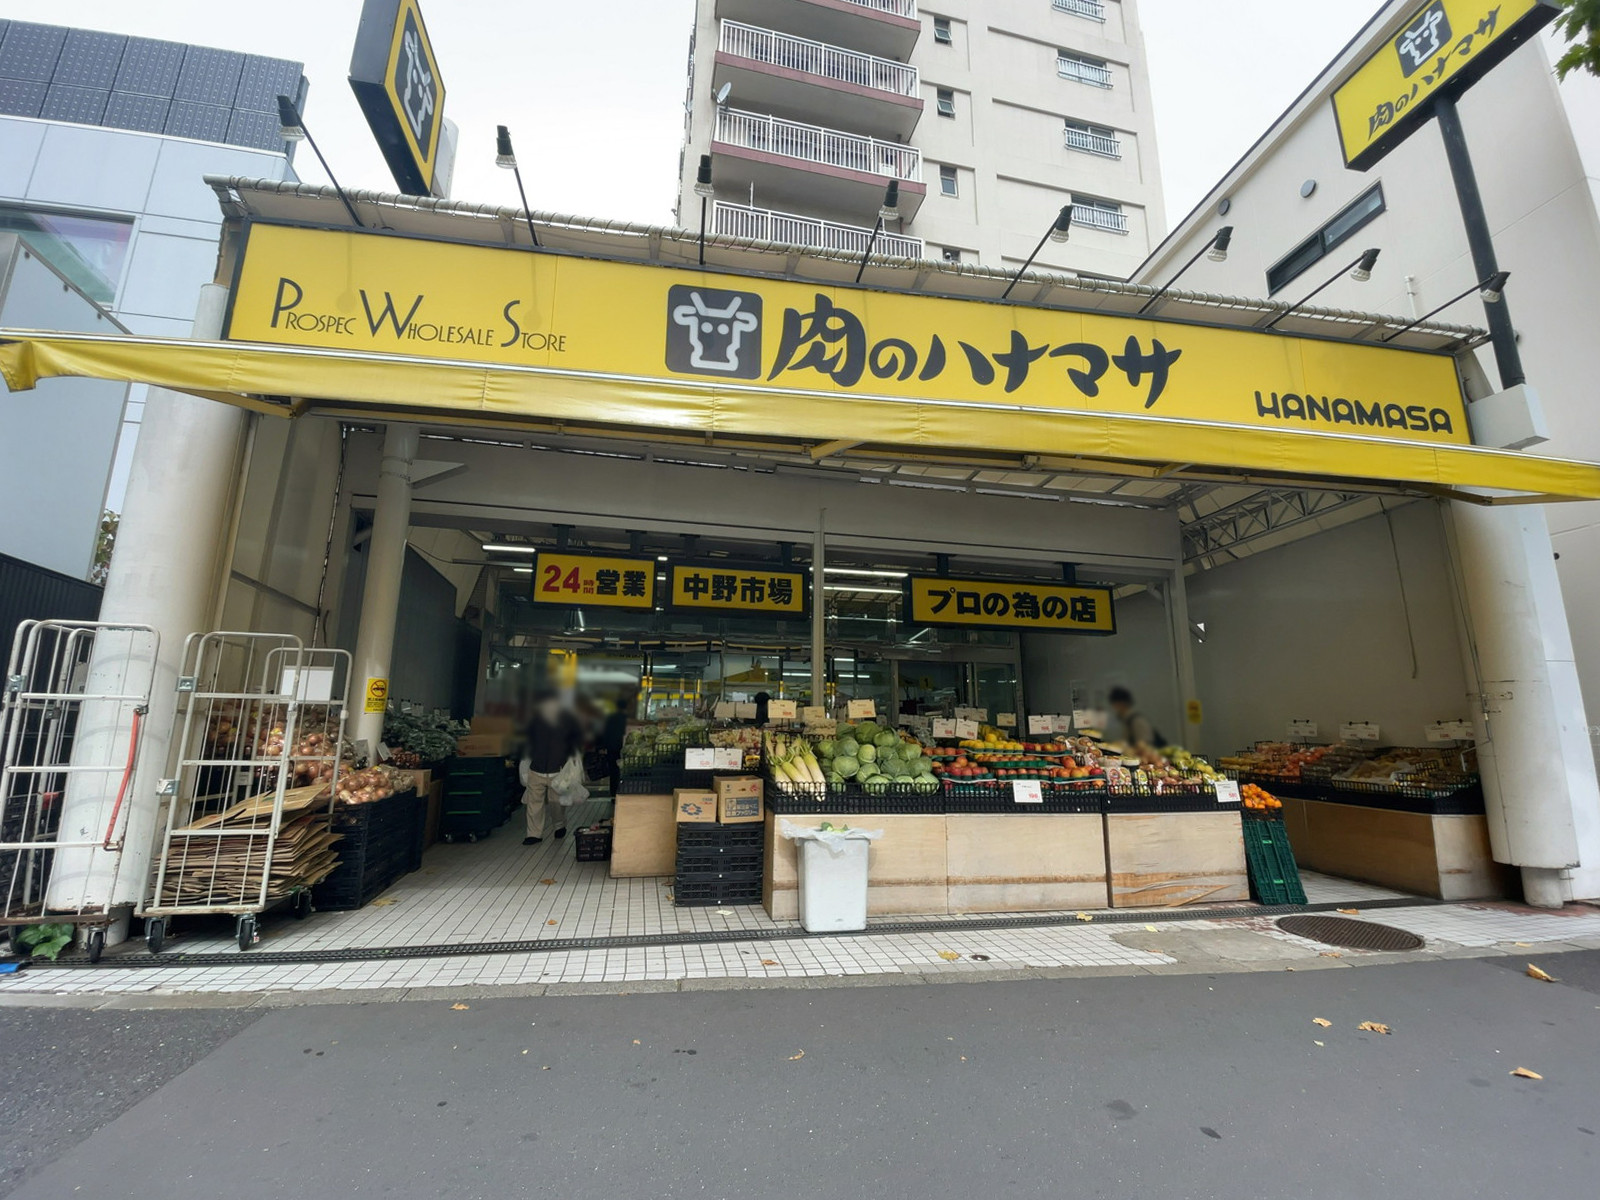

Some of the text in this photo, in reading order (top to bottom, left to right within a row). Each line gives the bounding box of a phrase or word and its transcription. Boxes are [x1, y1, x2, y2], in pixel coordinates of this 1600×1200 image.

[1368, 4, 1502, 141] 肉のハナマサ
[767, 293, 1182, 409] 肉のハナマサ
[1254, 390, 1453, 434] HANAMASA
[683, 573, 793, 605] 中野市場
[927, 586, 1097, 623] プロの為の店
